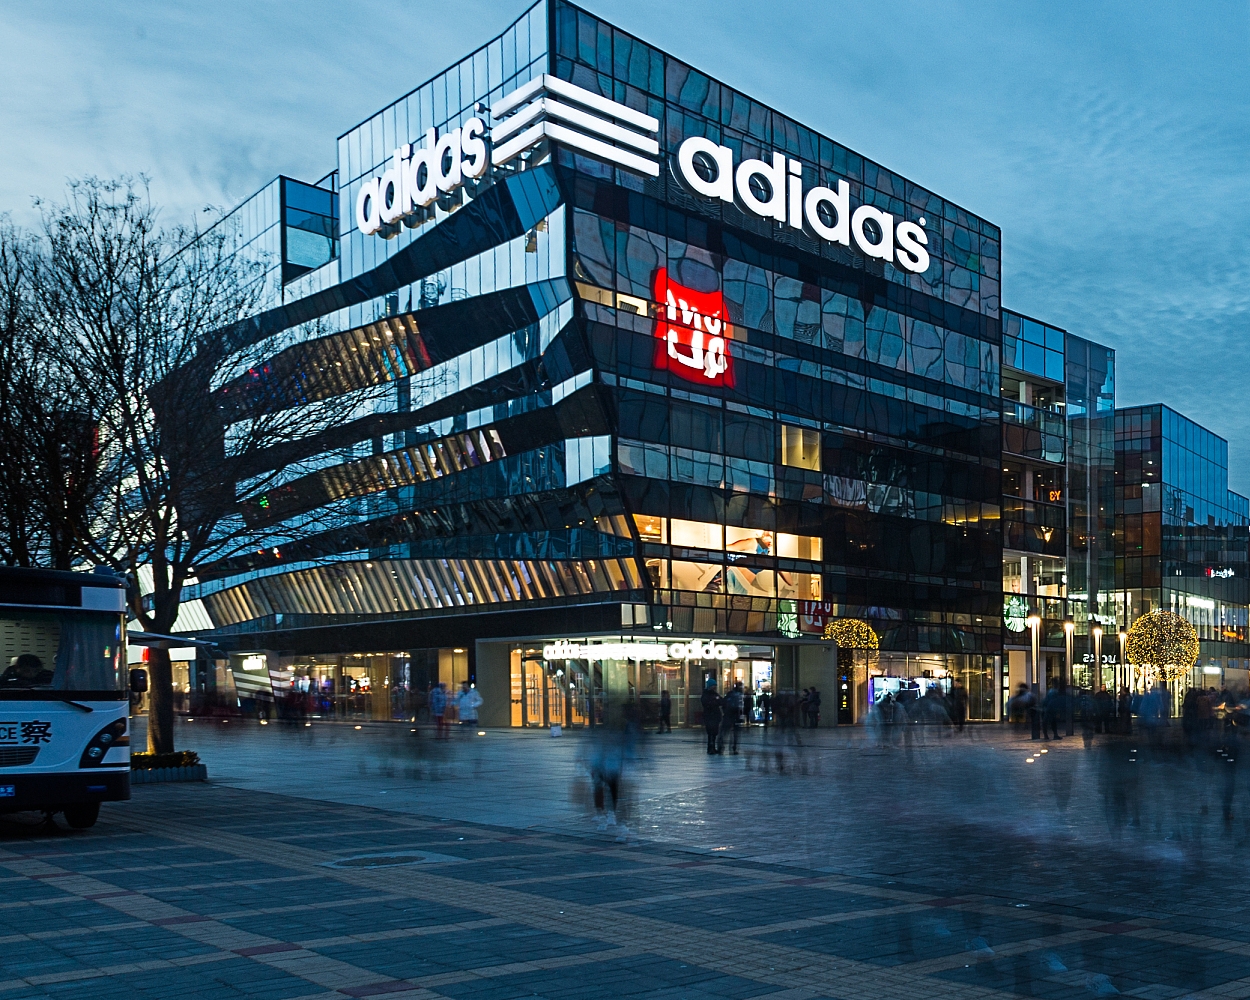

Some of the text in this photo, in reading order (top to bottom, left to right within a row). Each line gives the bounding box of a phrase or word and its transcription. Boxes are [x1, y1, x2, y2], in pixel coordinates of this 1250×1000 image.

[356, 117, 486, 235] adidas
[678, 136, 930, 273] adidas
[668, 639, 739, 661] adidas
[20, 720, 53, 744] 察
